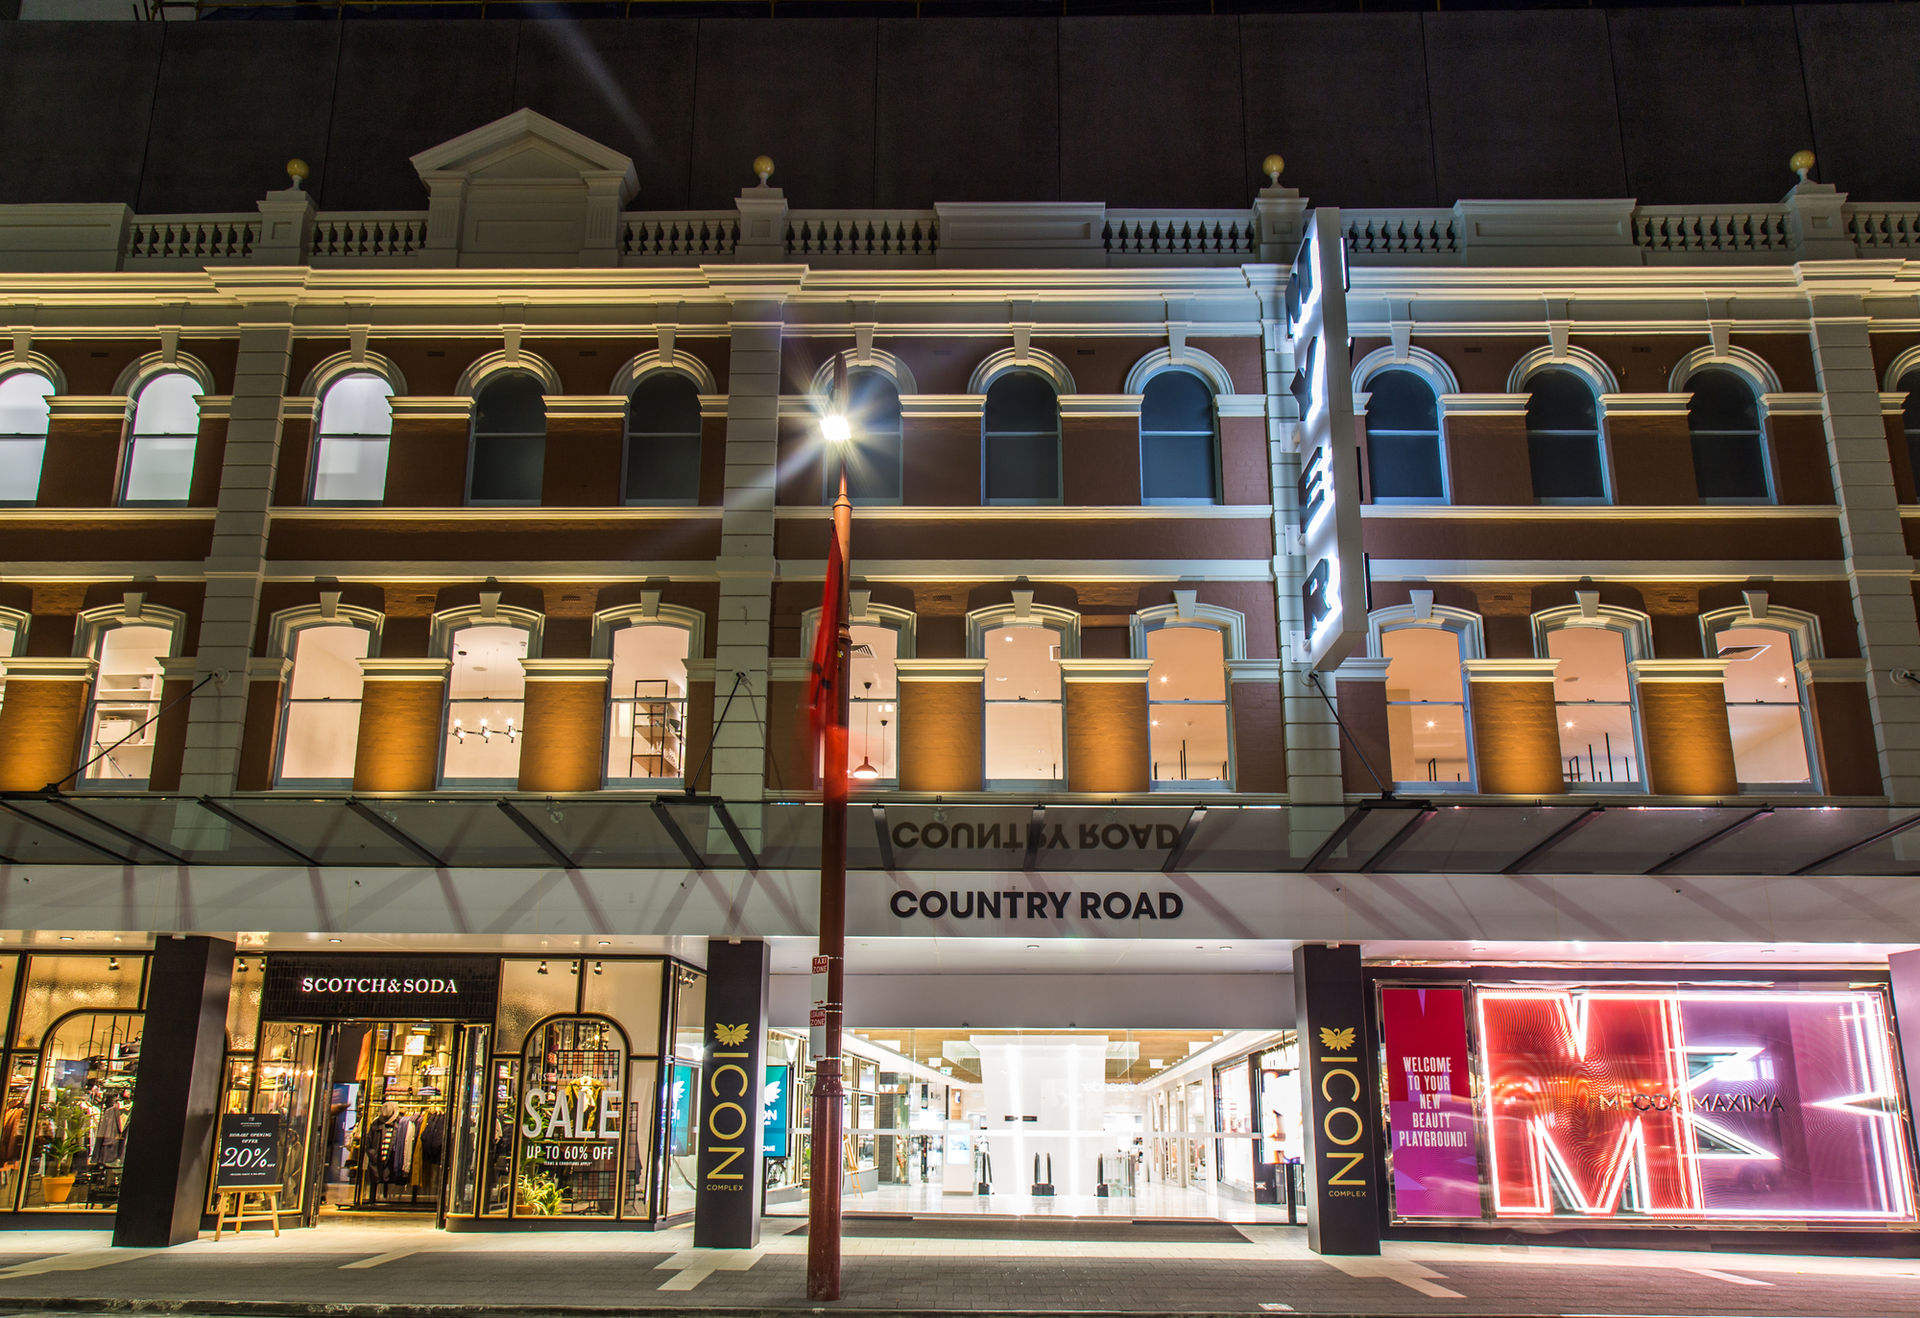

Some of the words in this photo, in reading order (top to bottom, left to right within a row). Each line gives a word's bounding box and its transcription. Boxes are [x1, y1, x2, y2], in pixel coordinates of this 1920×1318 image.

[890, 890, 1071, 919] COUNTRY
[1080, 891, 1184, 919] ROAD
[813, 966, 827, 974] ZONE
[814, 957, 827, 966] TAXI
[301, 977, 458, 993] SCOTCH&SODA
[810, 1019, 825, 1027] ZONE
[1402, 1056, 1452, 1073] WELCOME
[1408, 1075, 1420, 1091] TO
[1424, 1075, 1450, 1091] YOUR
[1419, 1093, 1440, 1110] NEW
[1600, 1093, 1683, 1112] MECCA
[1691, 1093, 1785, 1112] MAXIMA
[522, 1088, 622, 1139] SALE
[707, 1052, 749, 1180] ICON
[1320, 1056, 1366, 1186] ICON
[1412, 1112, 1450, 1129] BEAUTY
[1399, 1130, 1468, 1148] PLAYGROUND!
[220, 1146, 270, 1168] 20%
[526, 1145, 541, 1159] UP
[546, 1145, 560, 1159] TO
[564, 1146, 588, 1160] 60%
[592, 1146, 614, 1160] OFF
[1328, 1190, 1367, 1198] COMPLEX
